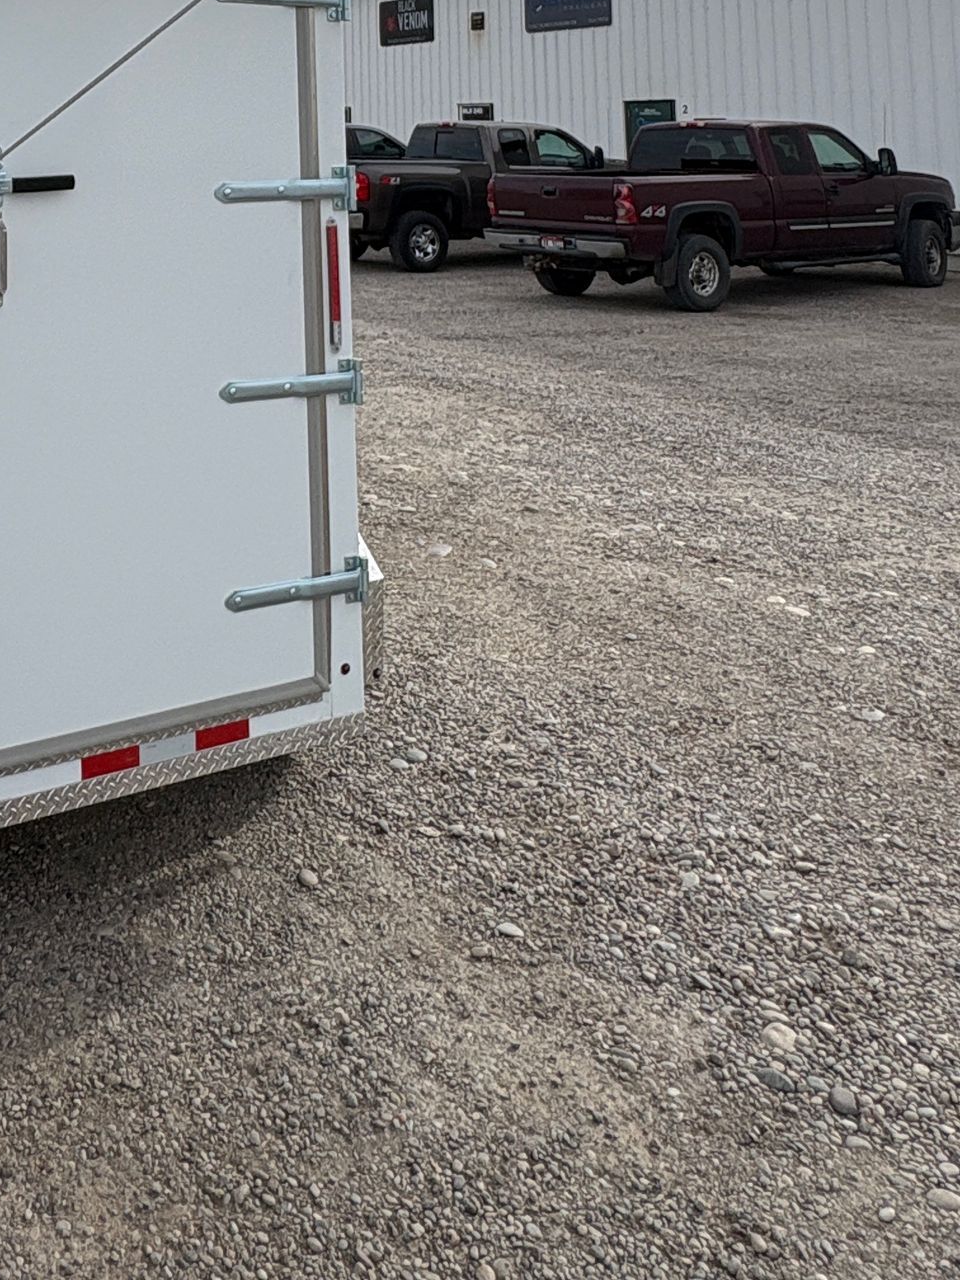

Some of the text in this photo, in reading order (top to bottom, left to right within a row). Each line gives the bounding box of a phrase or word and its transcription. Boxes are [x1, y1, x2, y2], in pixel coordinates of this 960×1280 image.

[397, 0, 416, 12] BLACK
[397, 9, 428, 32] VENOM
[682, 104, 688, 114] 2
